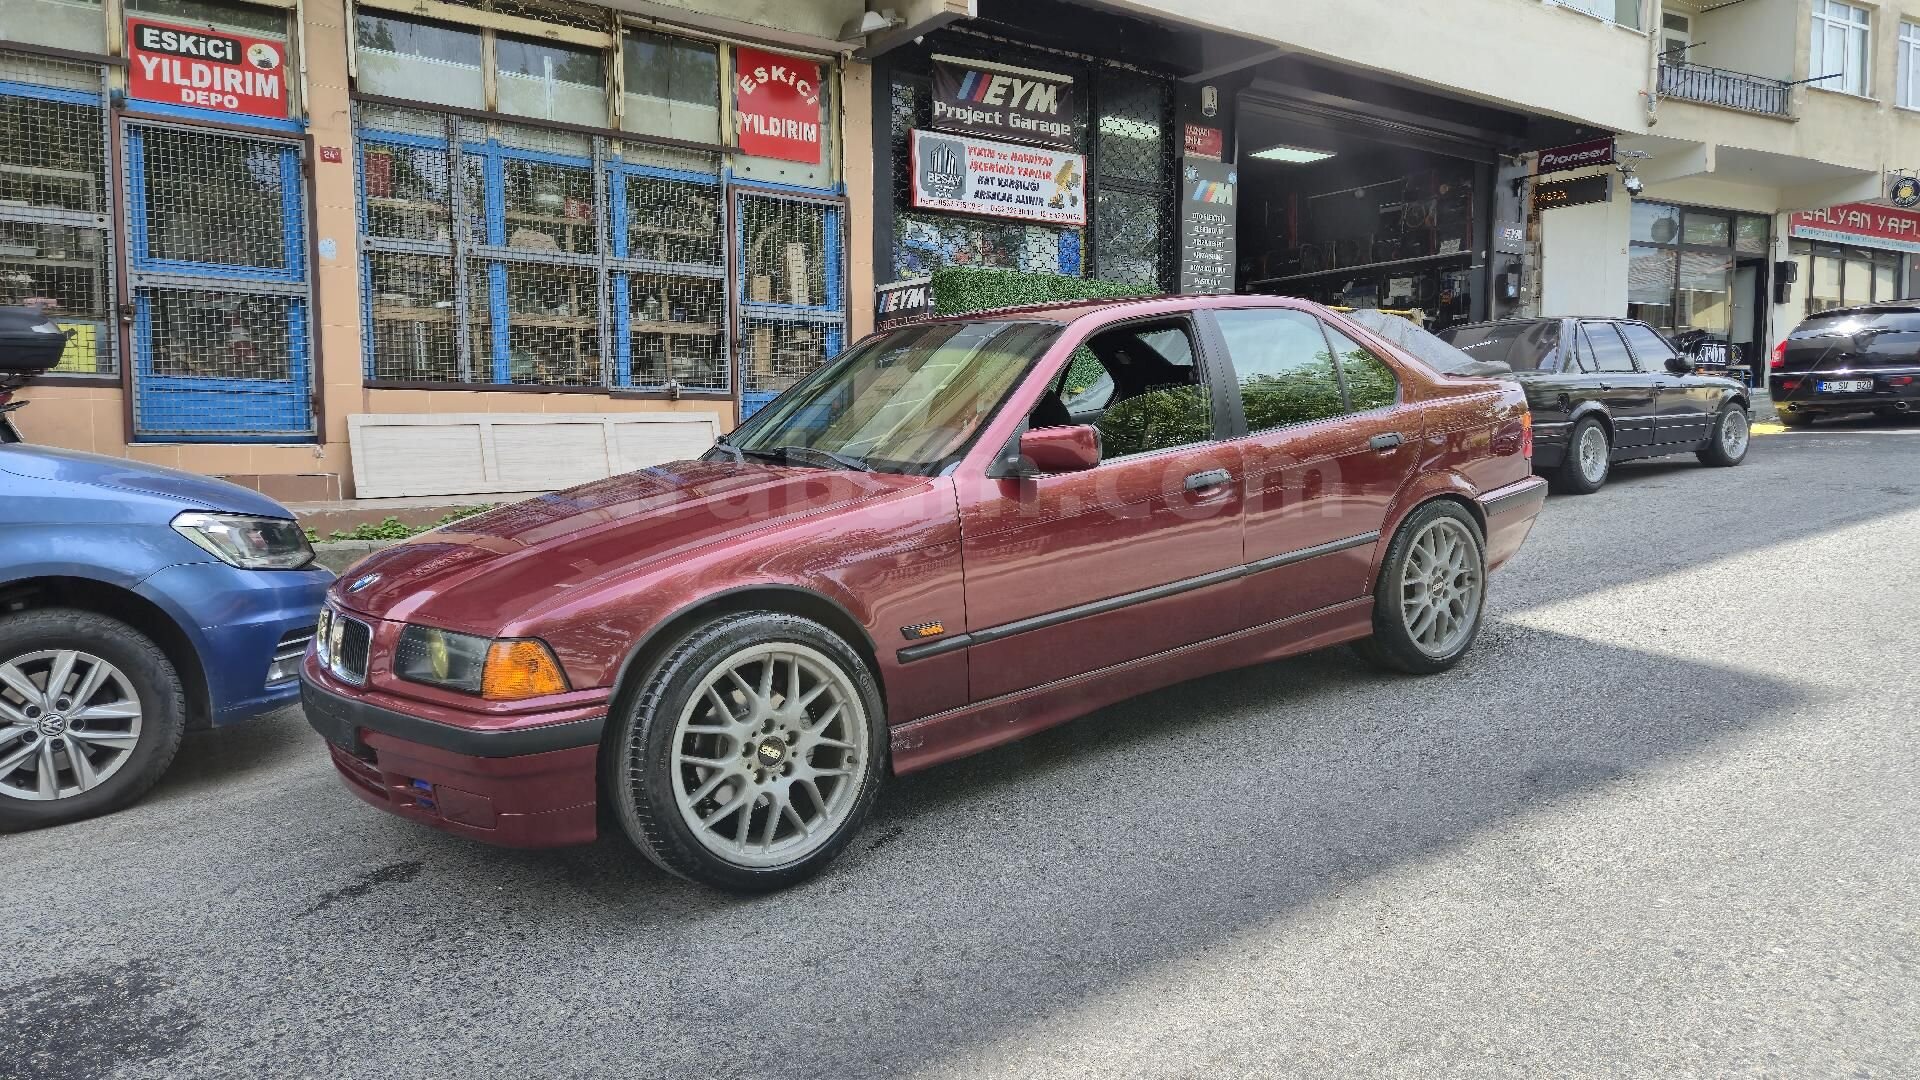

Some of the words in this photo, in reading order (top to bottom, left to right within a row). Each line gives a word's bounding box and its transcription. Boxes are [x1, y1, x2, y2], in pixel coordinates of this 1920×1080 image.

[138, 54, 279, 100] YILDIRIM
[181, 88, 239, 109] DEPO
[983, 74, 1057, 115] EYM
[741, 111, 817, 143] YILDIRIM
[933, 100, 1003, 126] Project
[1008, 112, 1071, 138] Garage
[1540, 147, 1609, 167] Pioneer
[926, 170, 963, 187] BESAY
[888, 286, 926, 313] EYM
